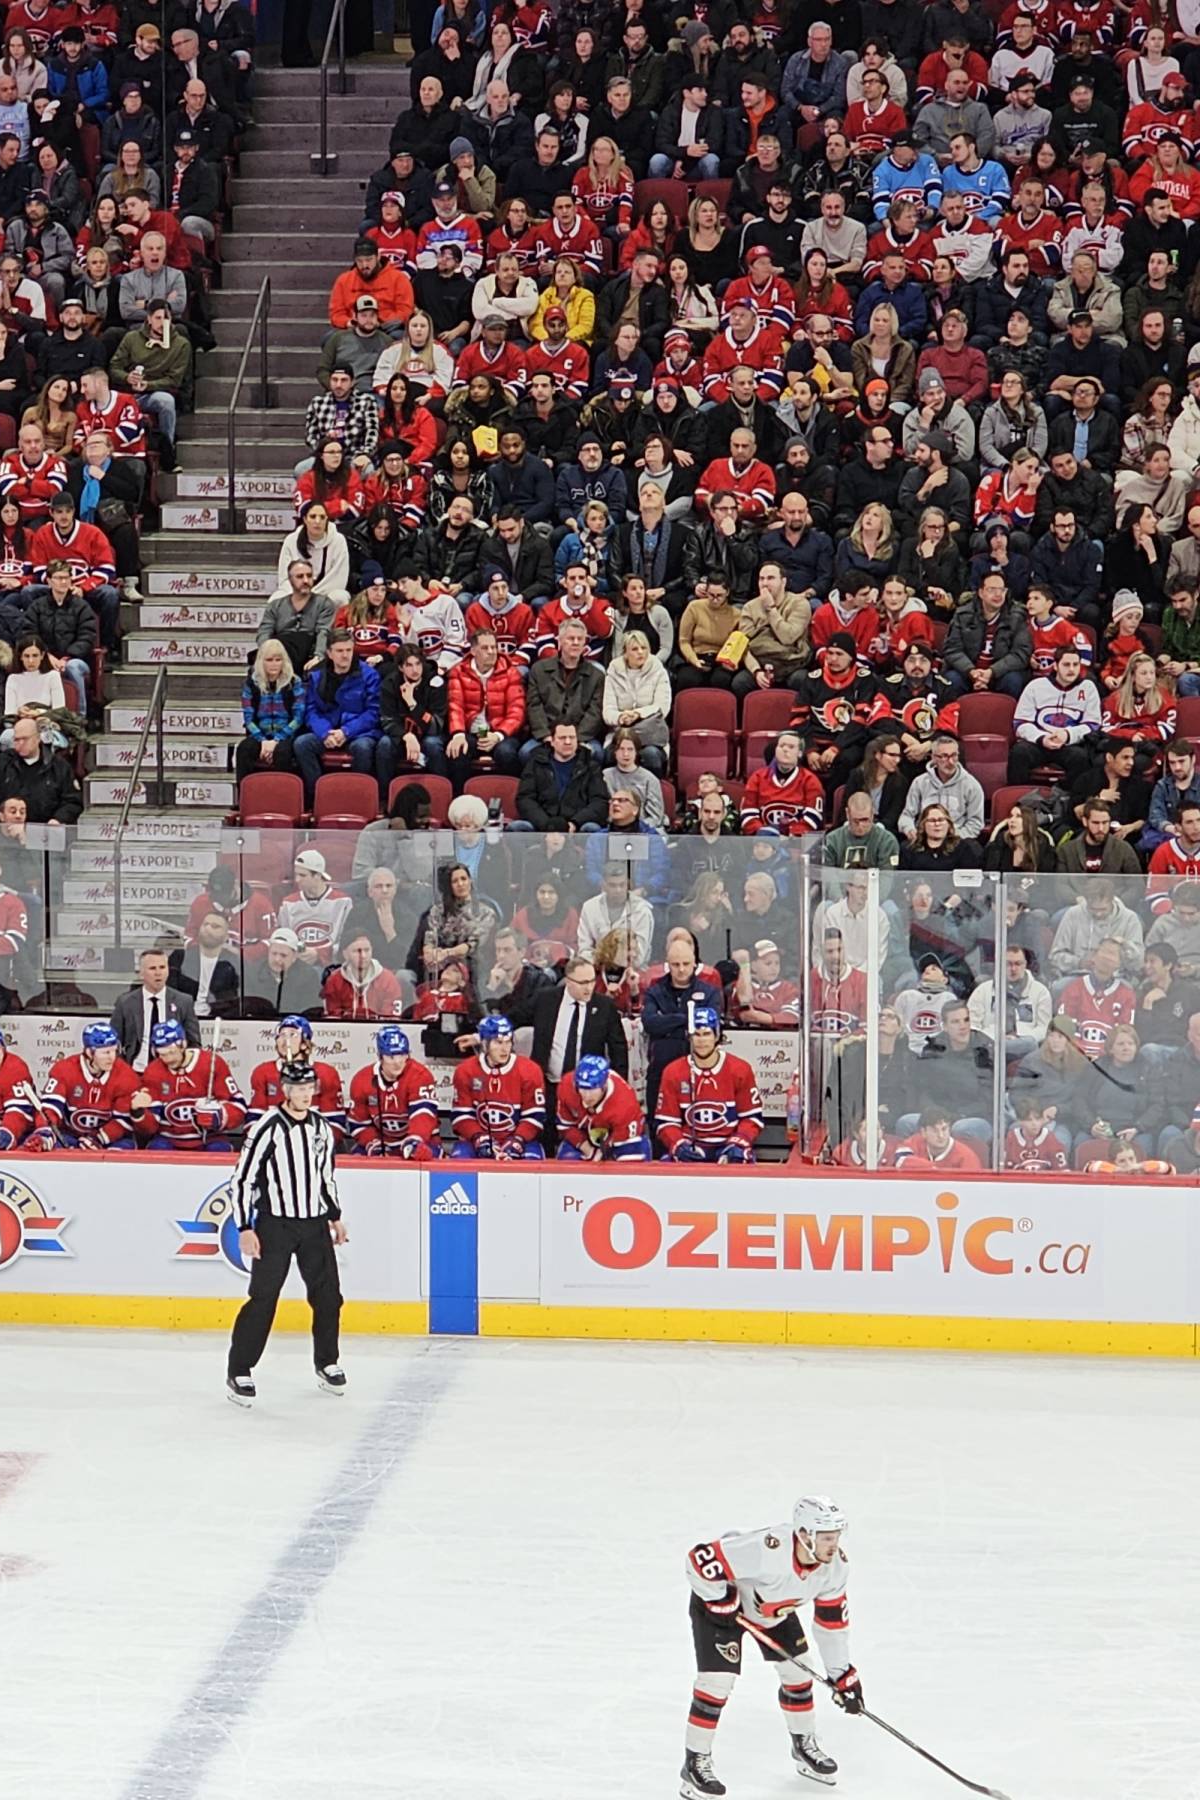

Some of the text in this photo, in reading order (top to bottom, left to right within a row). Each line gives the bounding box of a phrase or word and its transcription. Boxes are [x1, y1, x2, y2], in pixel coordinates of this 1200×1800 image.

[1077, 689, 1086, 702] A
[163, 750, 205, 761] XPORT
[44, 1077, 58, 1093] 8
[429, 1202, 477, 1216] adidas
[694, 1545, 724, 1580] 26
